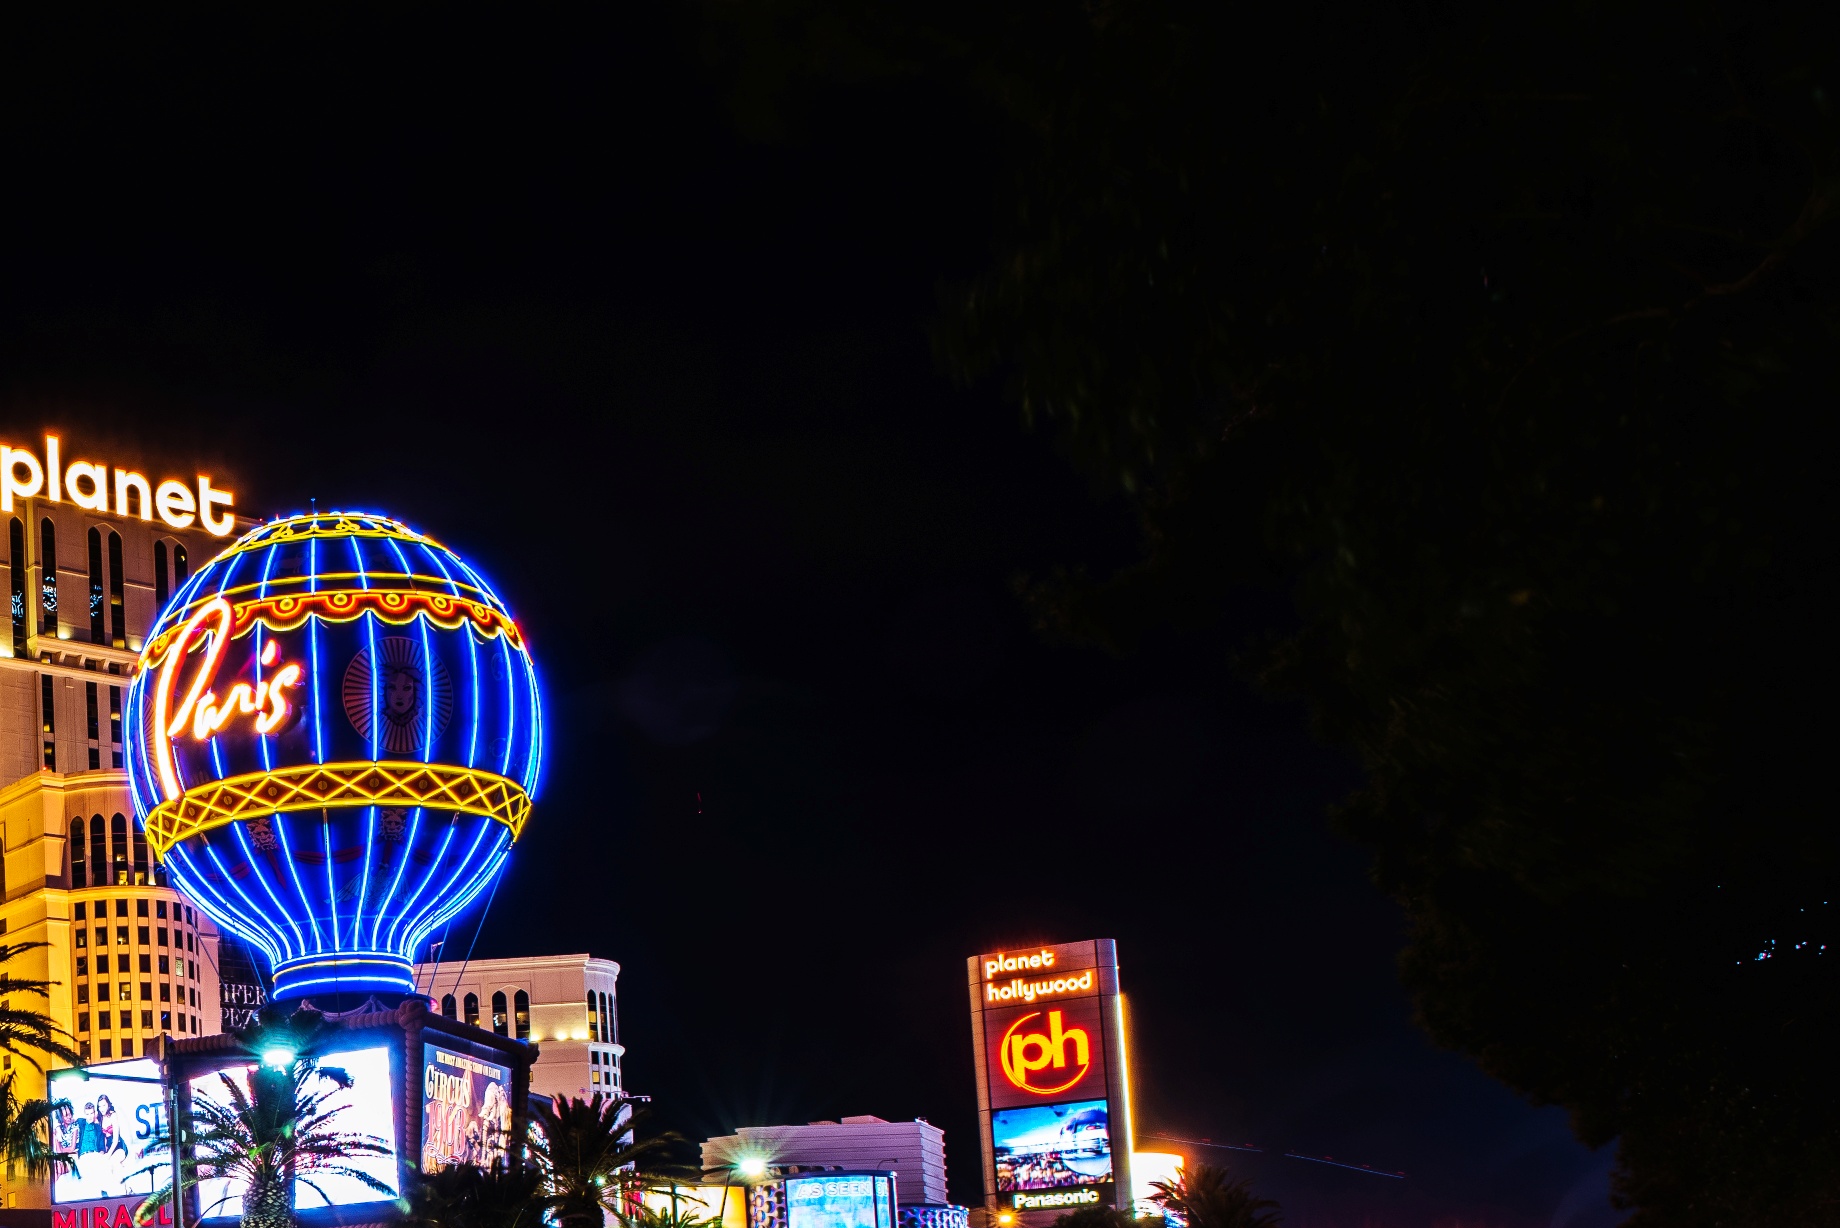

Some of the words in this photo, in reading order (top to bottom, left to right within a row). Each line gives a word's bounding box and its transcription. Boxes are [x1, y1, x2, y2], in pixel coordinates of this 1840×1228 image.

[0, 434, 236, 538] planet
[154, 597, 301, 801] Paris
[986, 950, 1055, 979] planet
[220, 983, 267, 1006] IFER
[988, 971, 1093, 1001] hollywood
[1010, 1010, 1090, 1085] ph
[425, 1064, 471, 1108] CIRCUS
[797, 1183, 822, 1198] AS
[826, 1182, 871, 1197] SEEN
[1013, 1188, 1100, 1209] Panasonic
